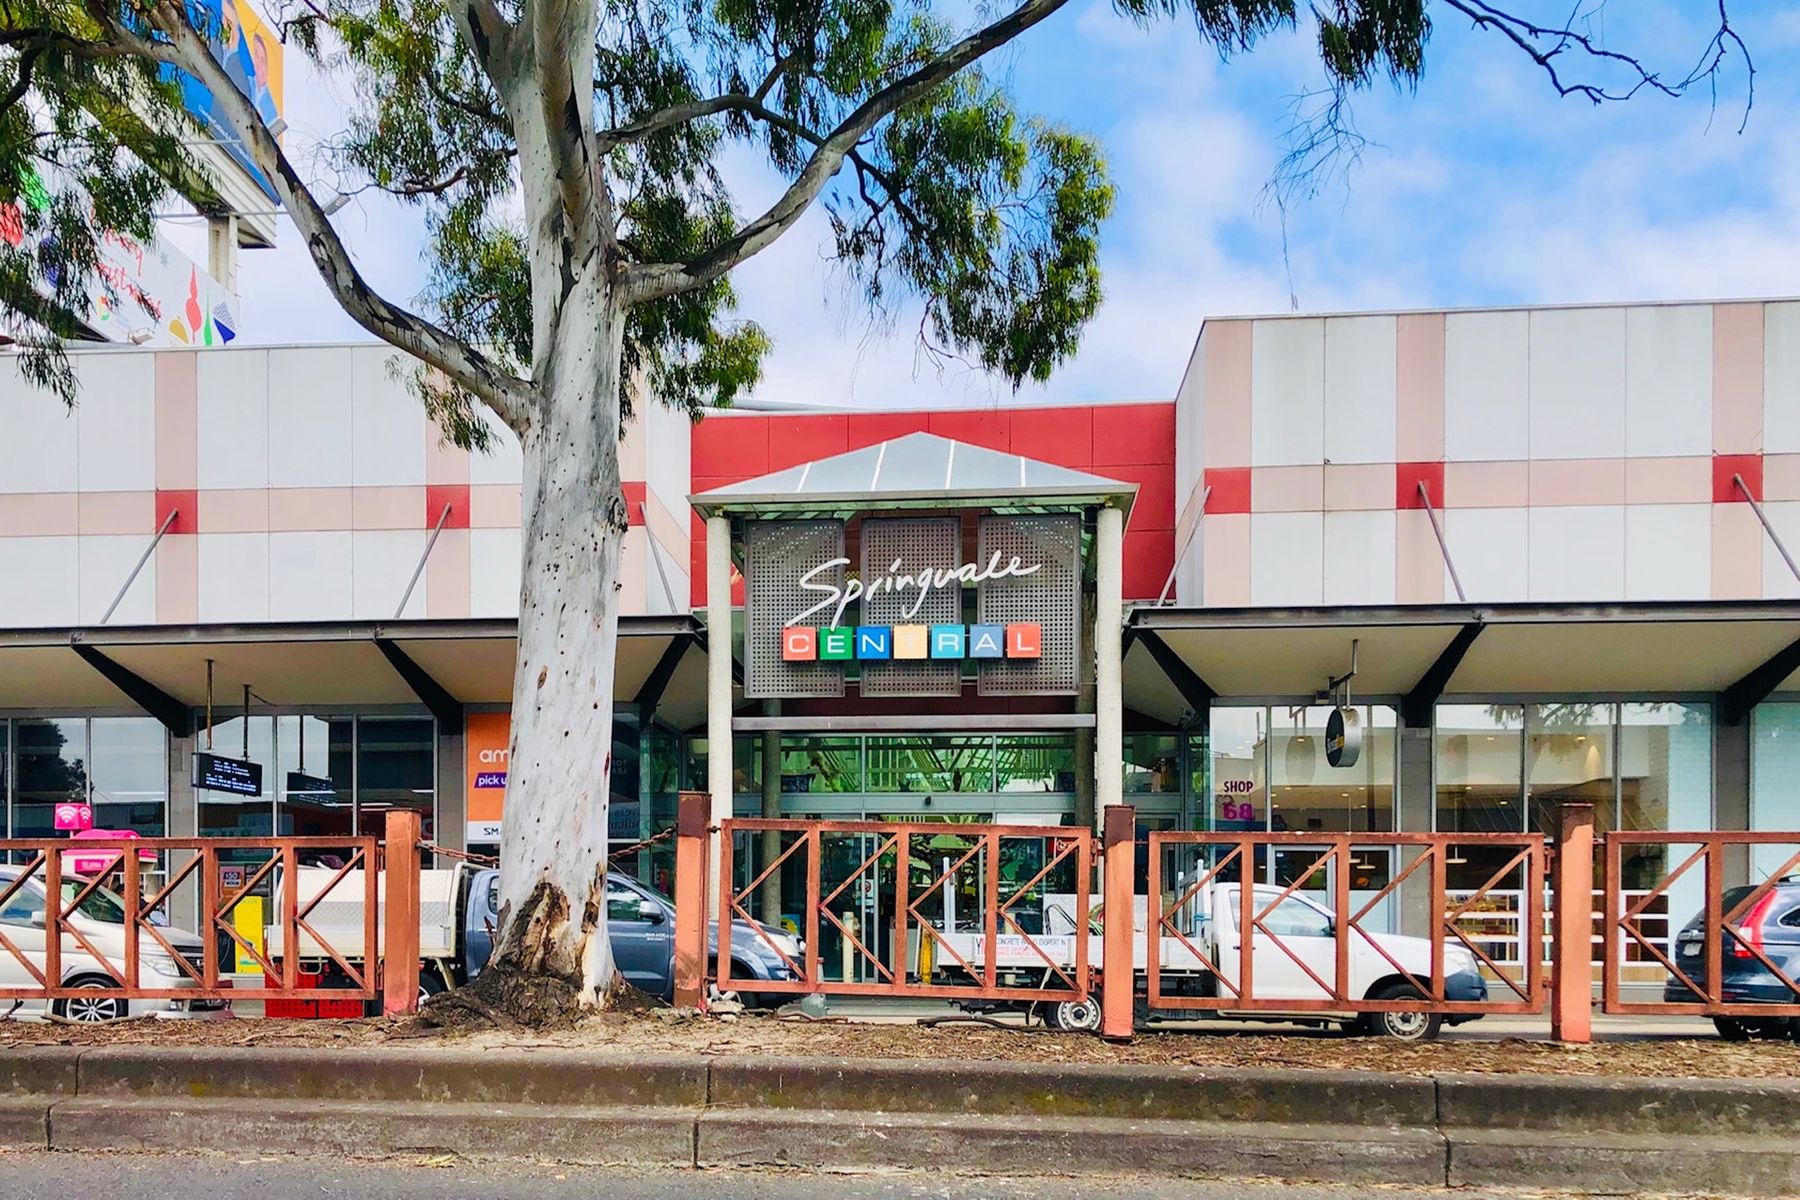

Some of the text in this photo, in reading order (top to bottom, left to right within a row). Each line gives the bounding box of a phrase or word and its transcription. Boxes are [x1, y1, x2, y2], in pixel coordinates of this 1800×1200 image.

[785, 550, 1042, 631] Springvale
[788, 633, 1035, 654] CENTRAL
[479, 749, 508, 763] am
[478, 775, 499, 787] pick
[1223, 781, 1254, 792] SHOP
[483, 827, 501, 836] SM
